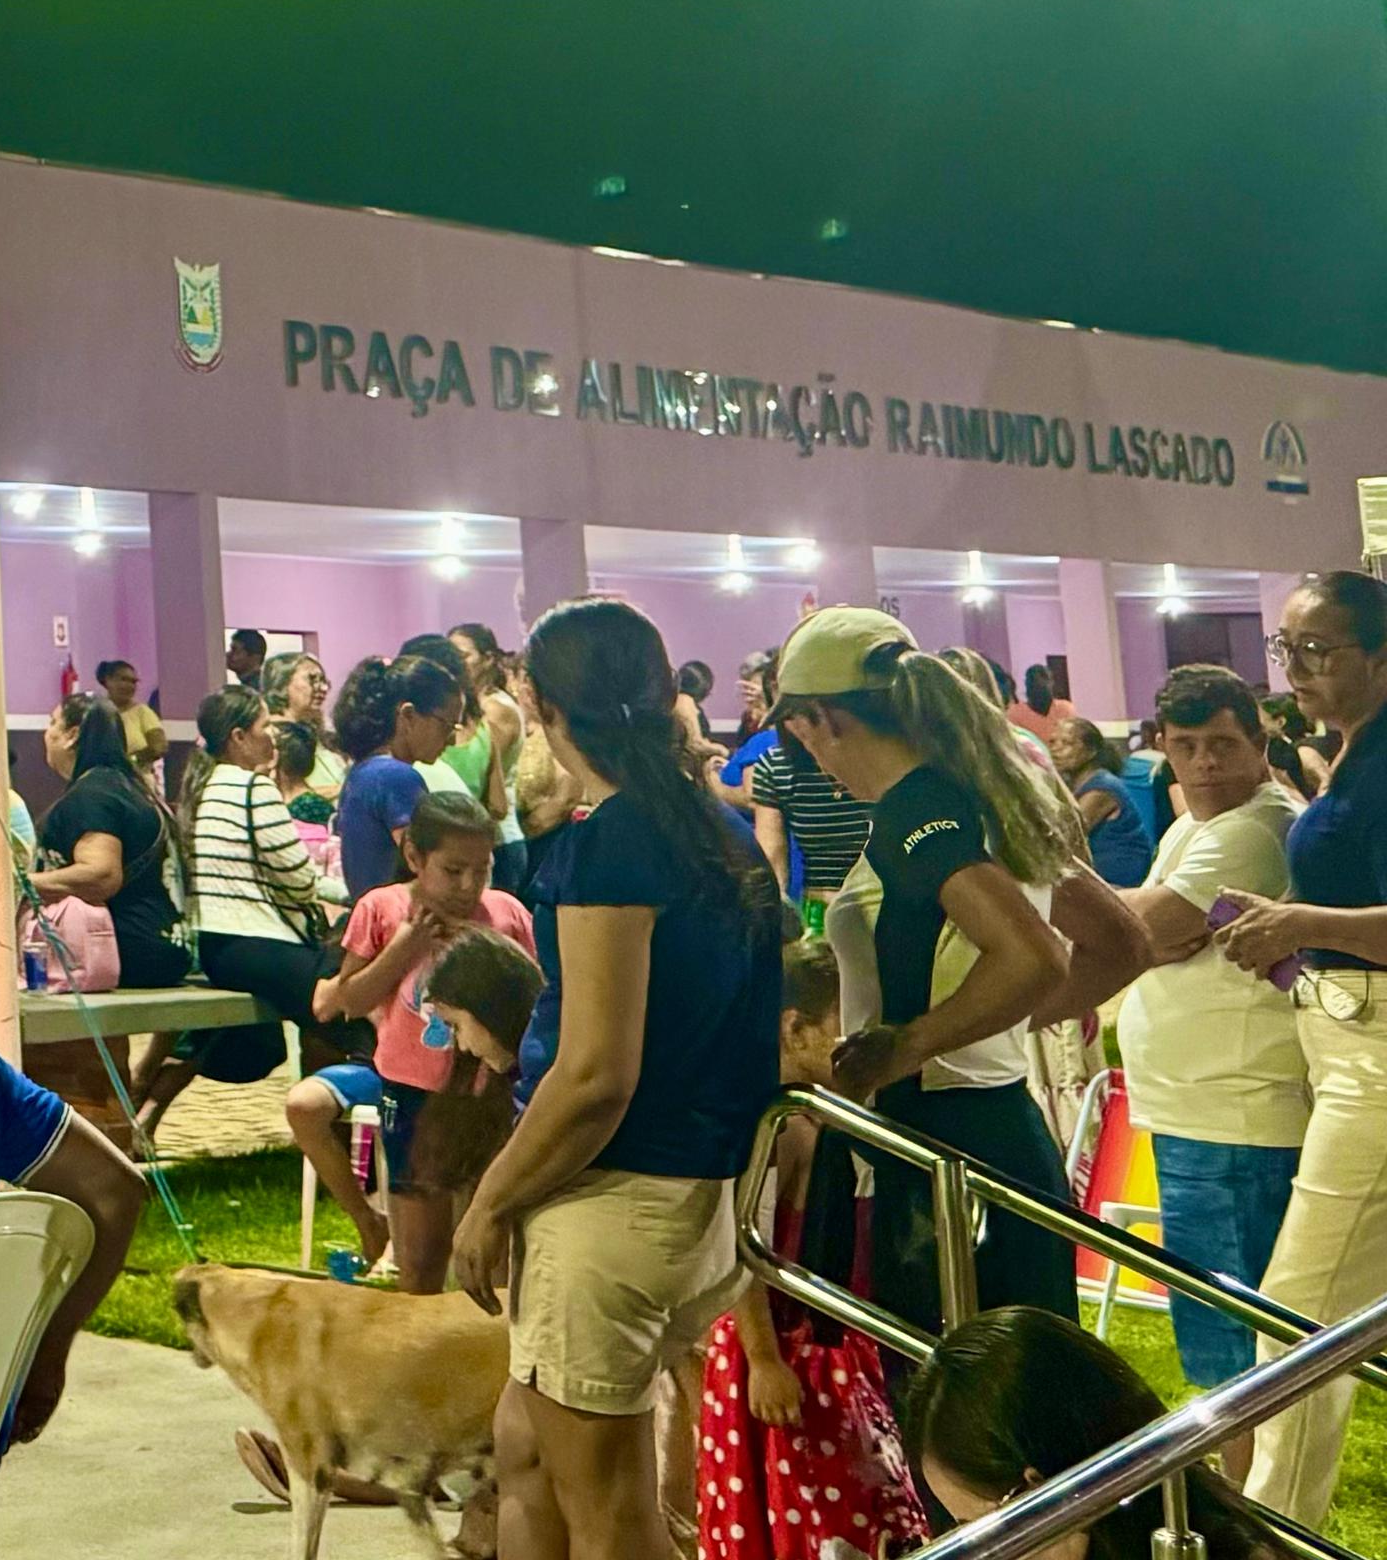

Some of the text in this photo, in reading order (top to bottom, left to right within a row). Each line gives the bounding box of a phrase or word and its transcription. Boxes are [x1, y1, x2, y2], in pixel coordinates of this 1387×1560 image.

[283, 319, 1236, 488] PRAÇA DE ALIMENTAÇÃO RAIMUNDO LASCADO
